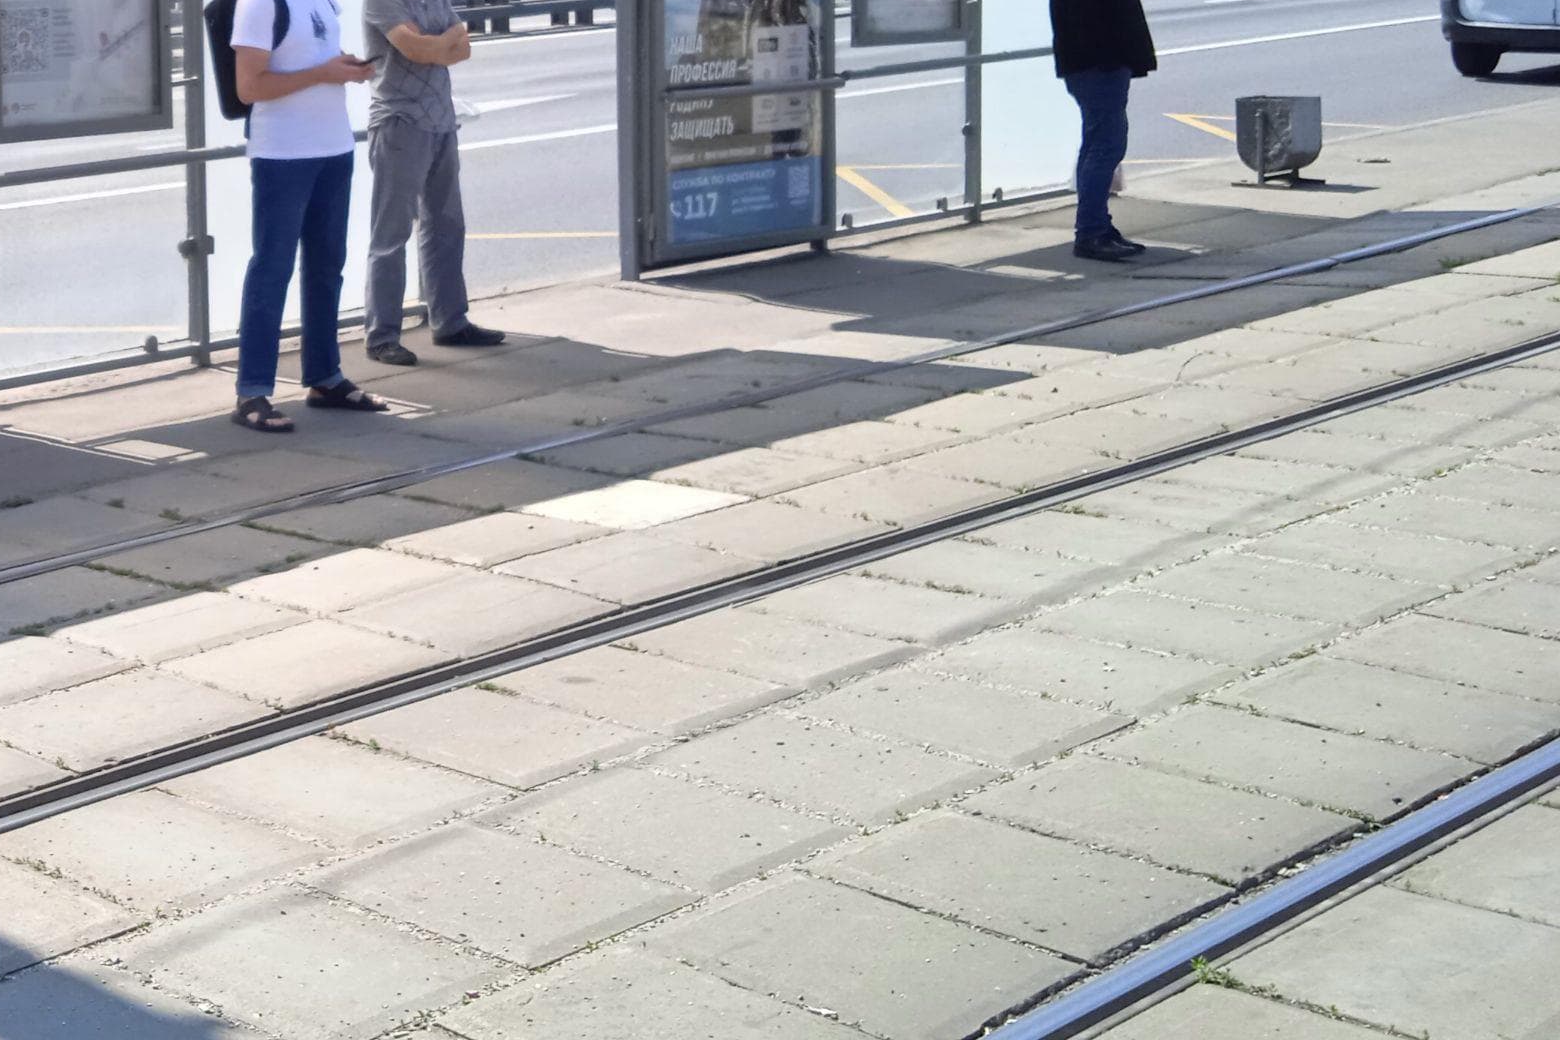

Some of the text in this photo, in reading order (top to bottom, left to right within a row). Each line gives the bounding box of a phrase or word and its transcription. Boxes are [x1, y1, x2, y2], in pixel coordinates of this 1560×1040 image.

[670, 33, 703, 55] НАША
[670, 60, 736, 83] ПРОФЕССИЯ
[670, 117, 733, 141] ЗАЩИЩАТЬ
[684, 192, 718, 220] 117
